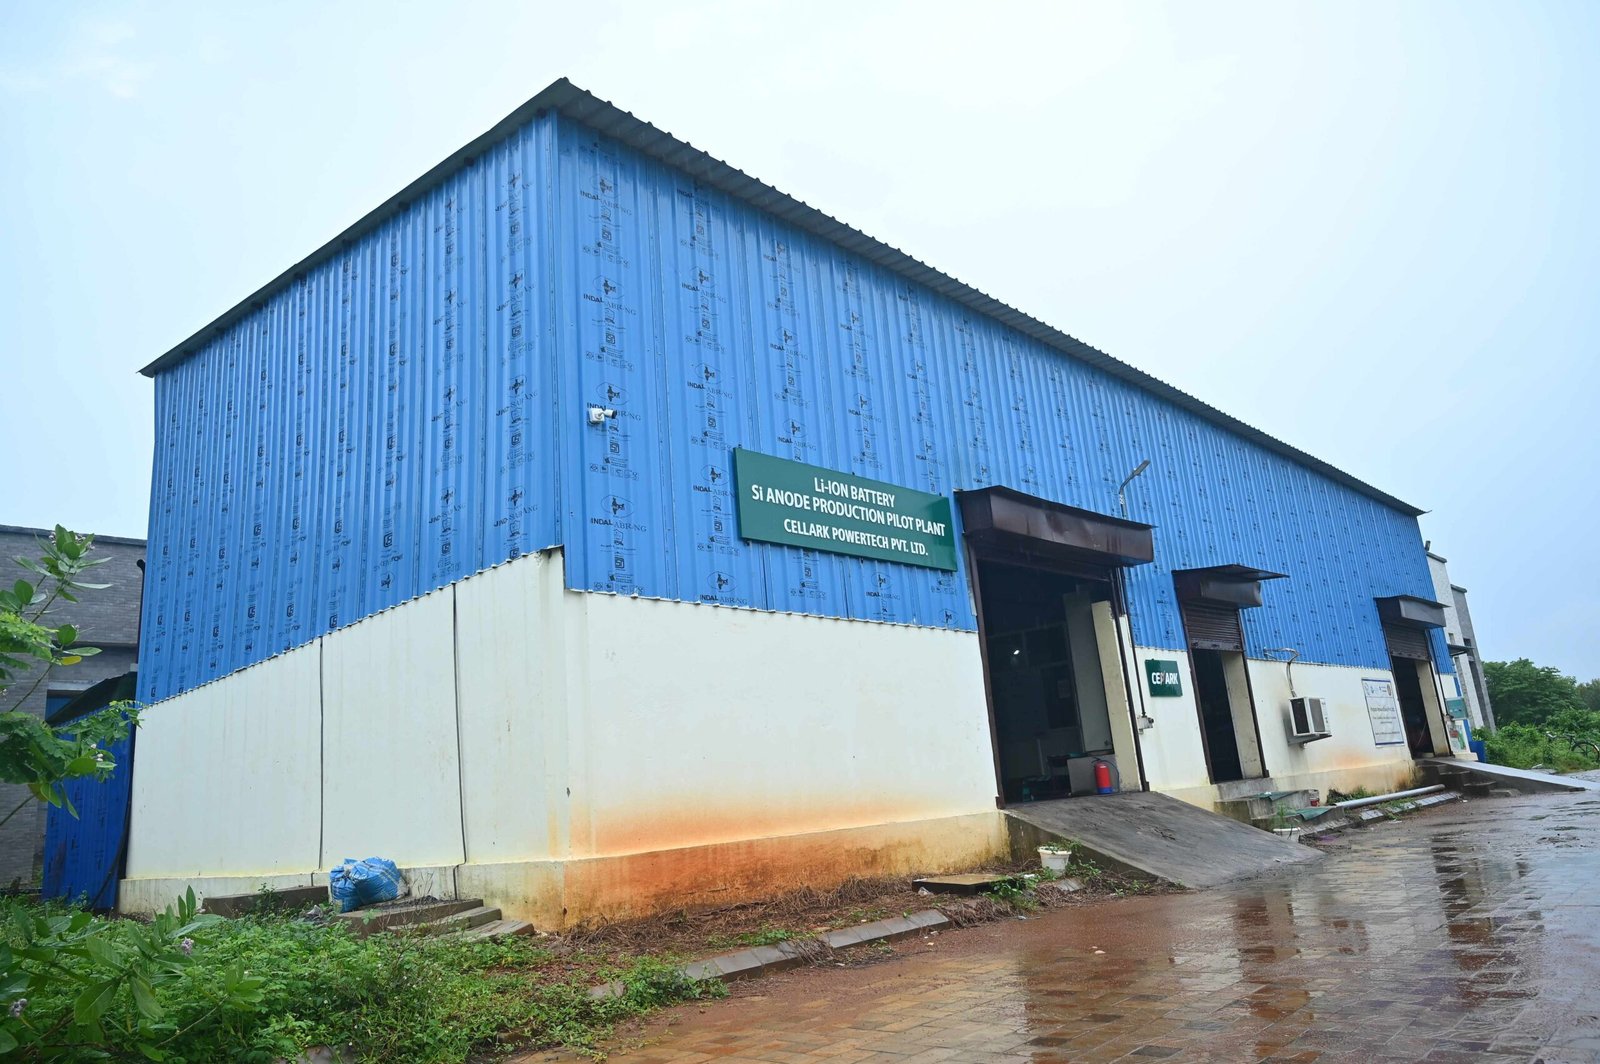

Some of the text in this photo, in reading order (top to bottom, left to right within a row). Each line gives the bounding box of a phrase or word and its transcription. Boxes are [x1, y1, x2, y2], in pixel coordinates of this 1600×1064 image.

[814, 477, 895, 508] Li-ION BATTERY
[751, 484, 763, 501] Si
[766, 488, 810, 510] ANODE
[812, 497, 885, 525] PRODUCTION
[886, 512, 914, 531] PILOT
[915, 518, 945, 536] PLANT
[784, 519, 929, 556] CELLARK POWERTECH PVT. LTD.
[1151, 671, 1178, 685] CEARK
